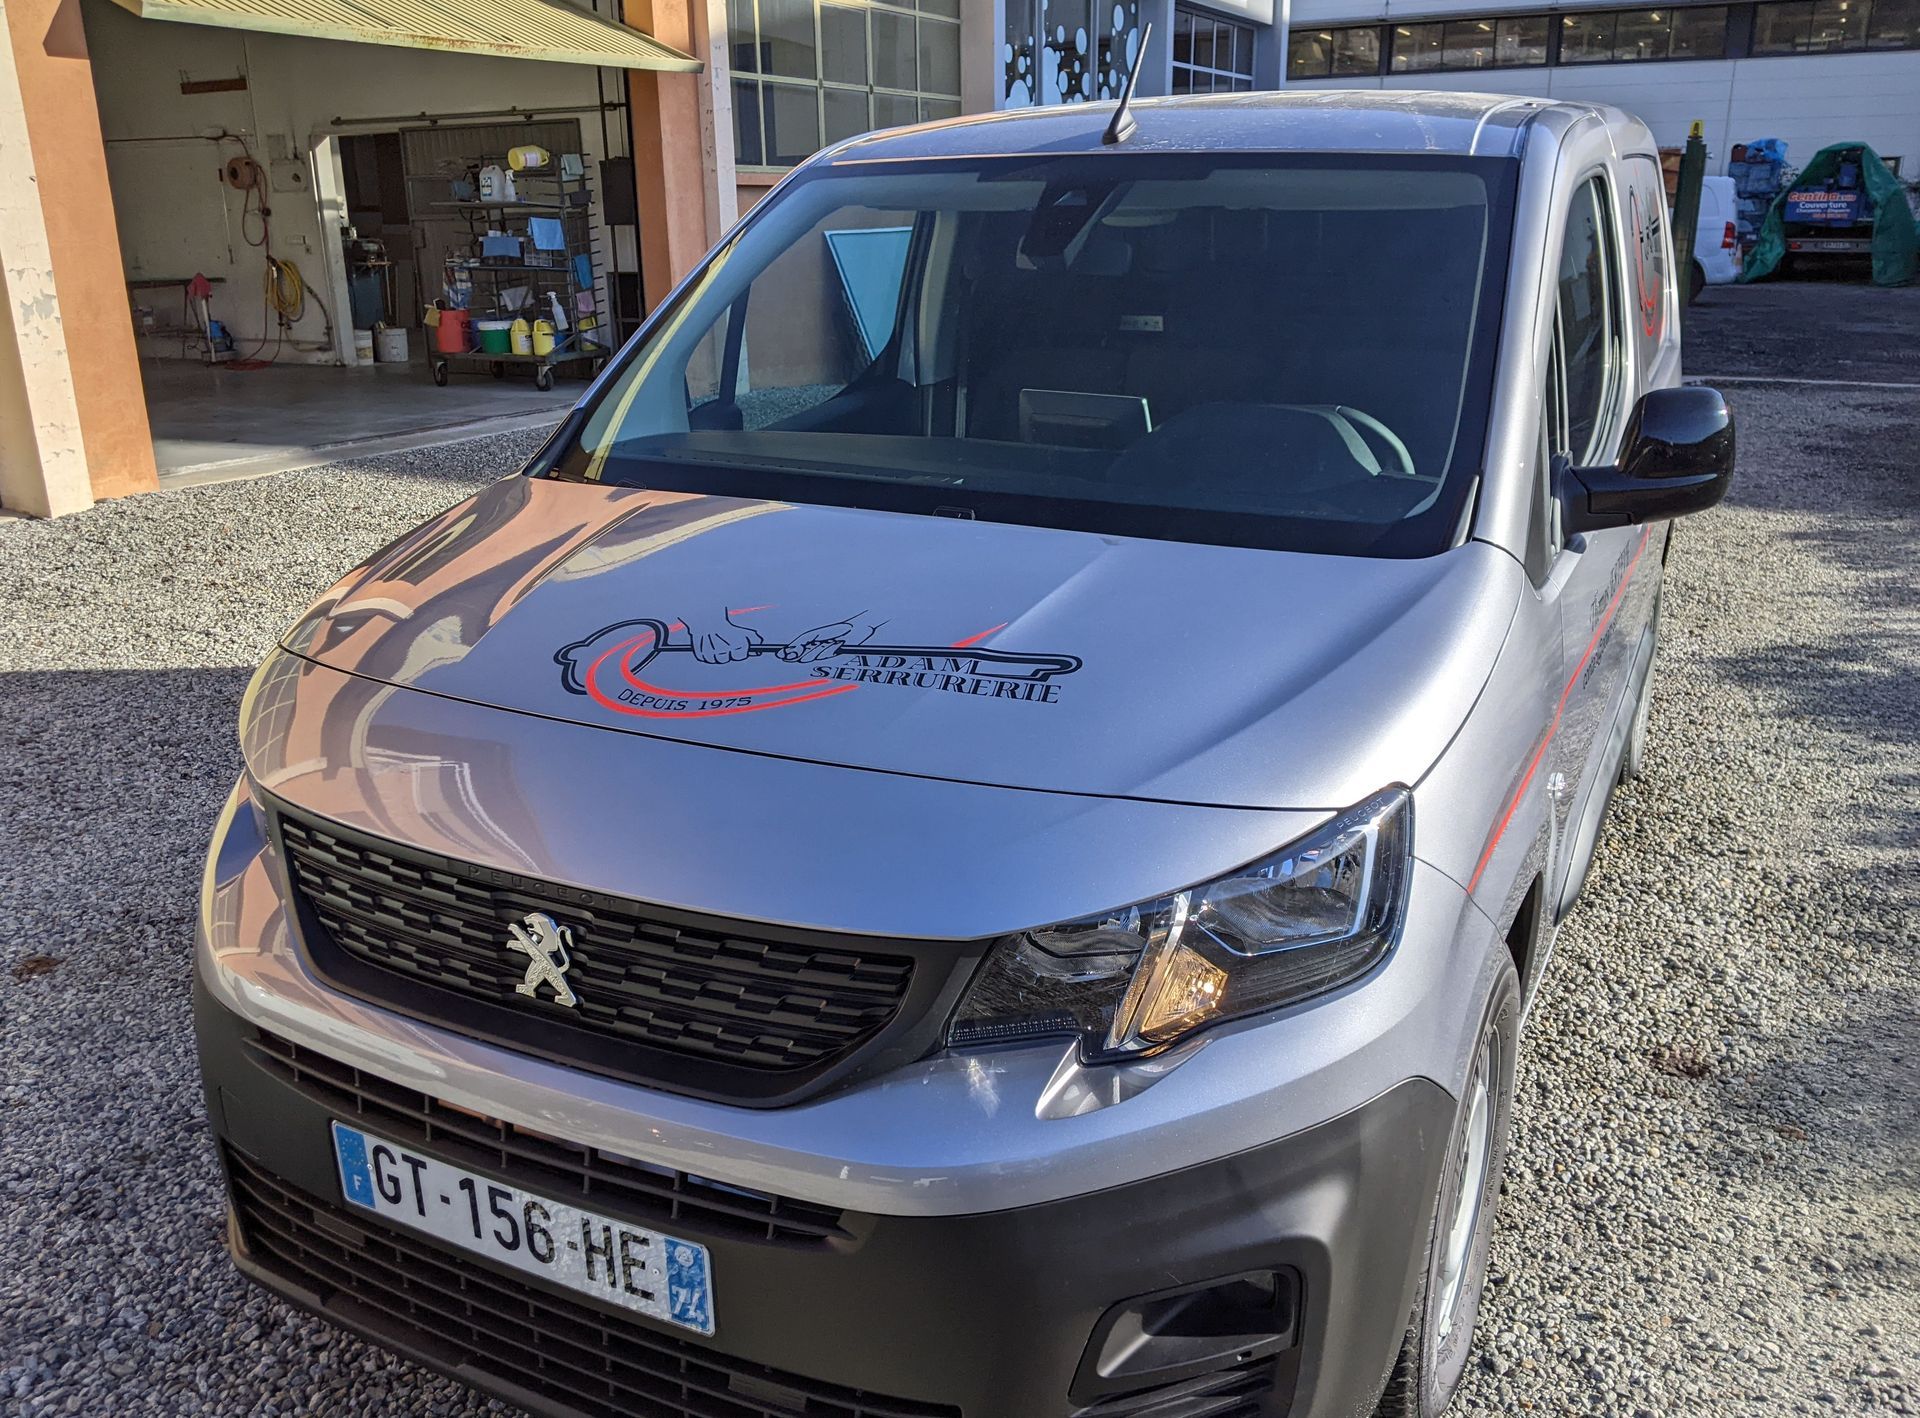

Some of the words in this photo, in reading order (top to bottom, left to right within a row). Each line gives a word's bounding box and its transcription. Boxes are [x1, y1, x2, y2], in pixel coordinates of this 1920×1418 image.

[844, 655, 982, 676] ADAM
[618, 688, 688, 711] DEPUIS
[698, 697, 752, 711] 1975
[810, 665, 1062, 704] SERRURERIE
[468, 864, 616, 909] PEUGEOT
[353, 1174, 362, 1191] F
[372, 1144, 655, 1301] GT-156-HE
